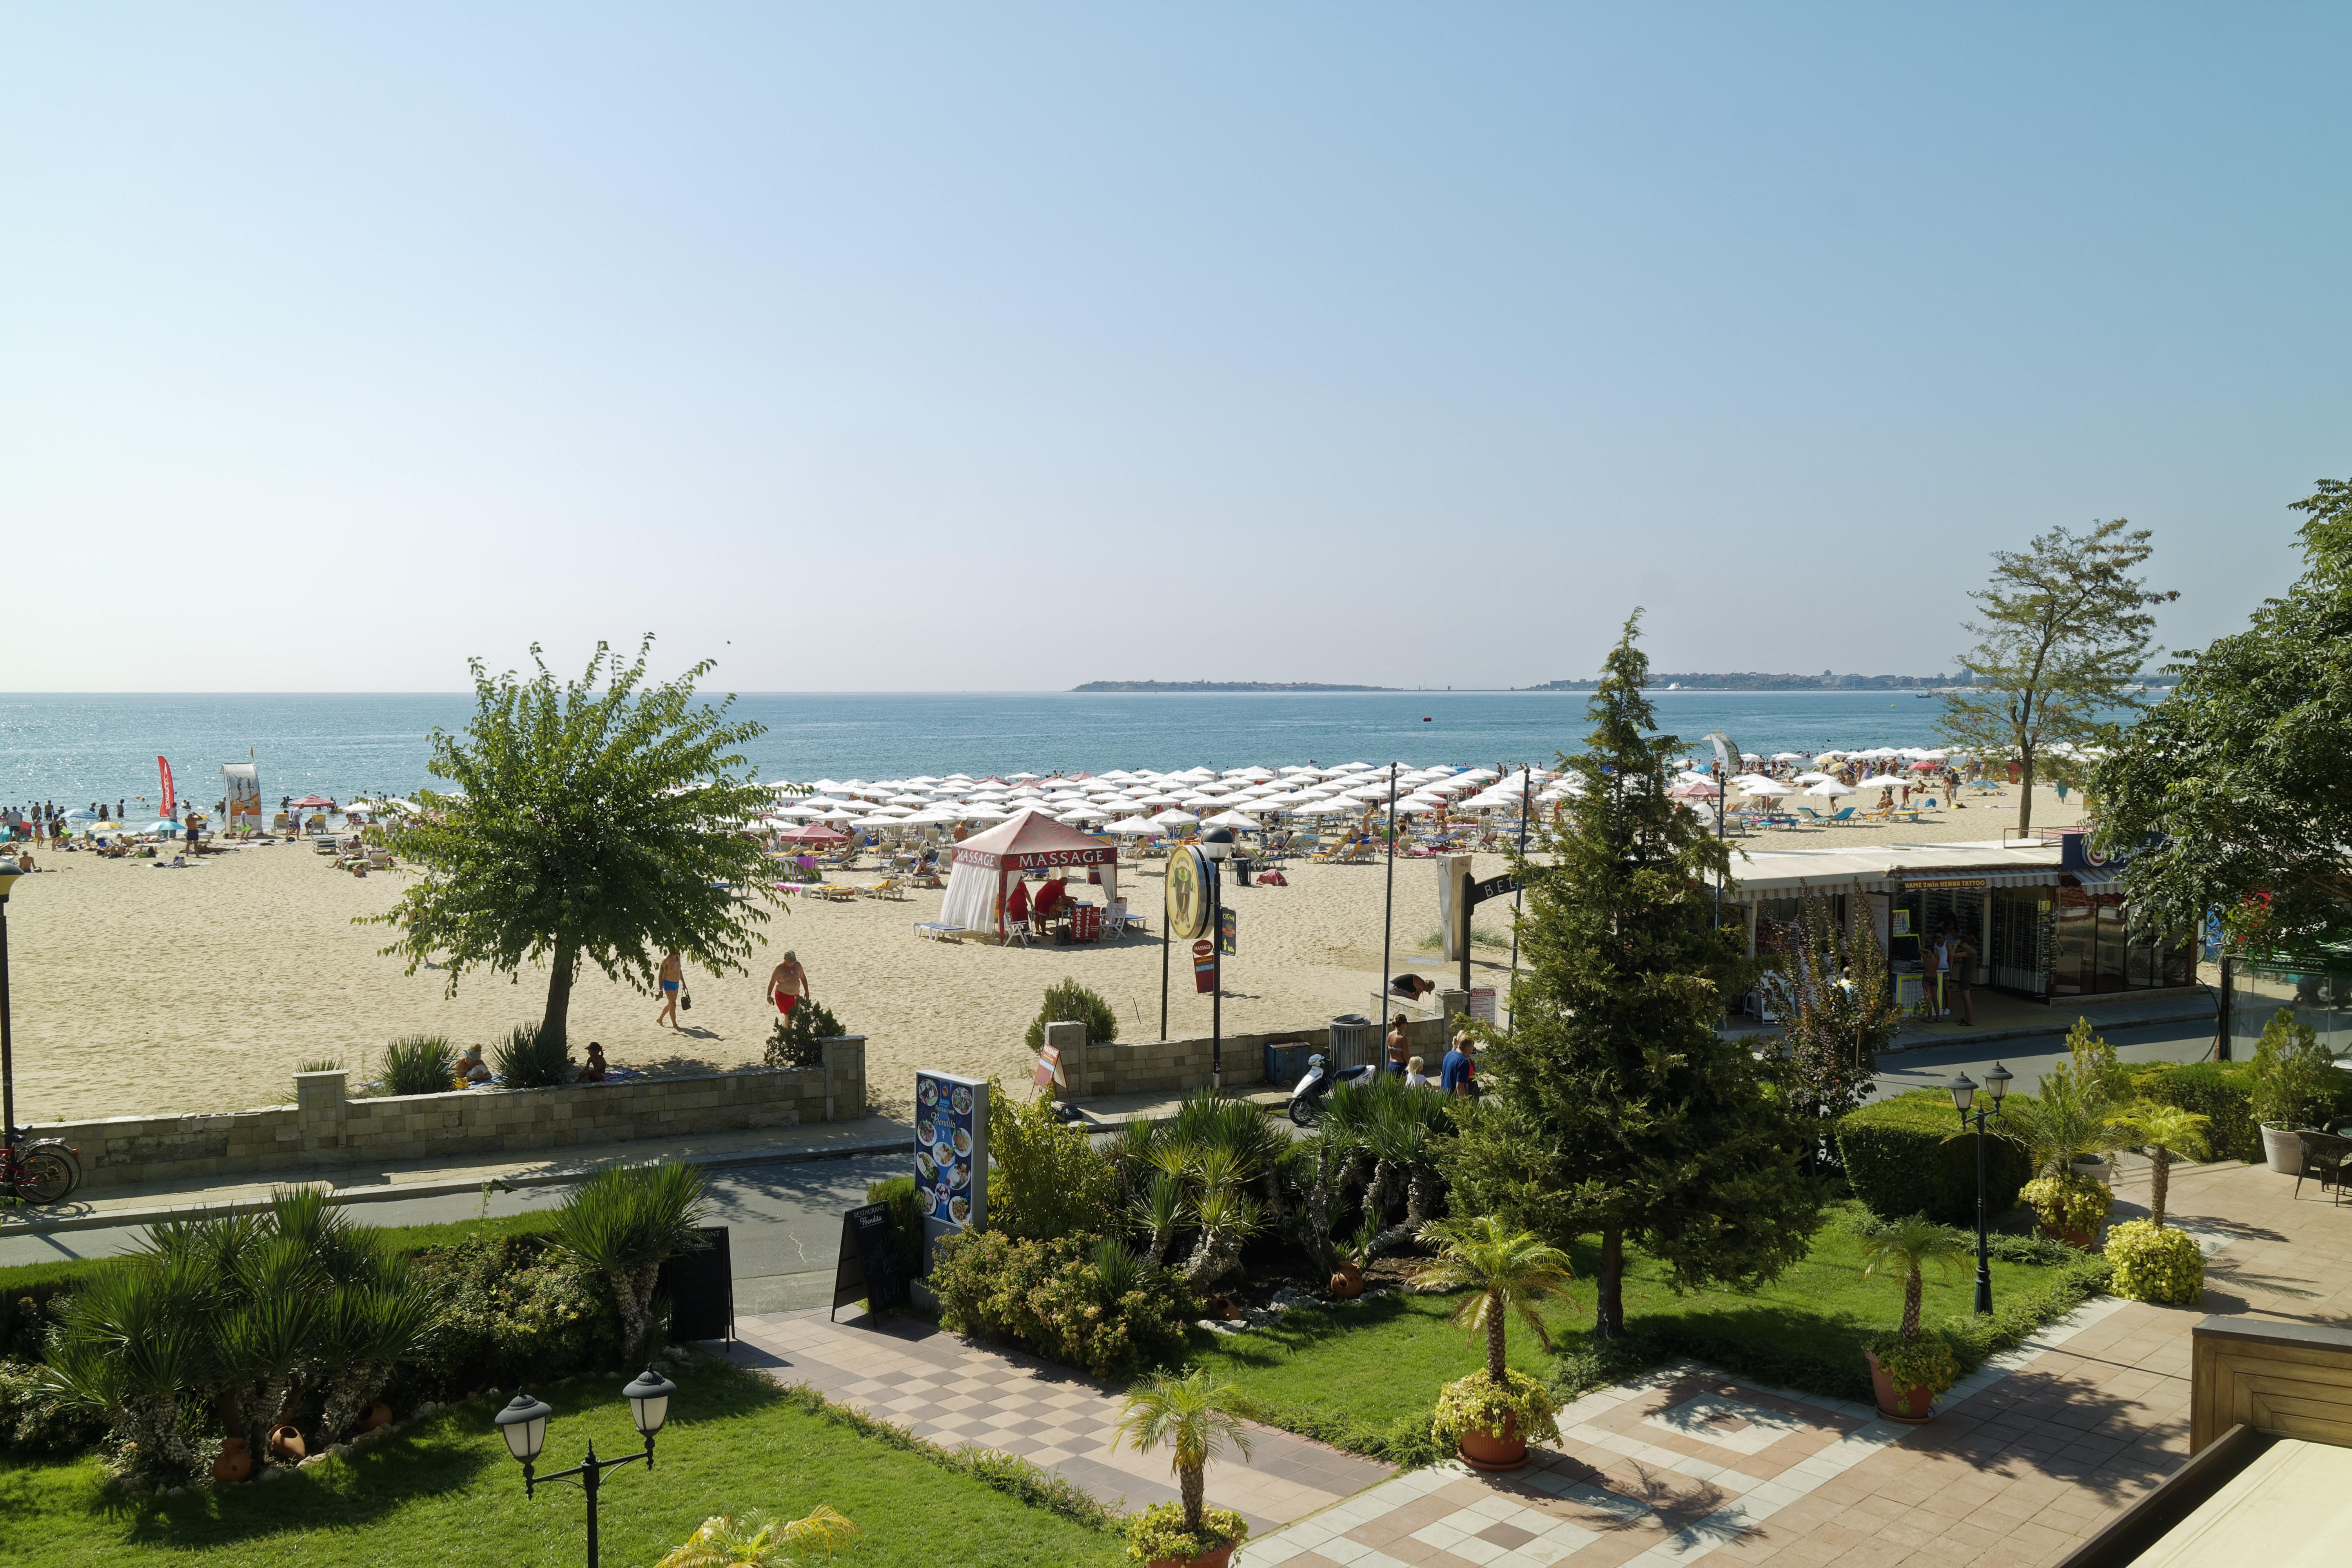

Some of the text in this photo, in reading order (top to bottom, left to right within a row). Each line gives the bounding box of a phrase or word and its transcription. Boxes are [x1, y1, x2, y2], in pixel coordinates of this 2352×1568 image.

[957, 849, 995, 867] MASSAGE
[1019, 850, 1104, 867] MASSAGE
[1223, 913, 1234, 922] CROWN
[935, 1105, 955, 1115] Restaurant
[931, 1112, 956, 1129] Bendita
[853, 1204, 885, 1218] RESTAURANT
[860, 1215, 882, 1226] Bendita
